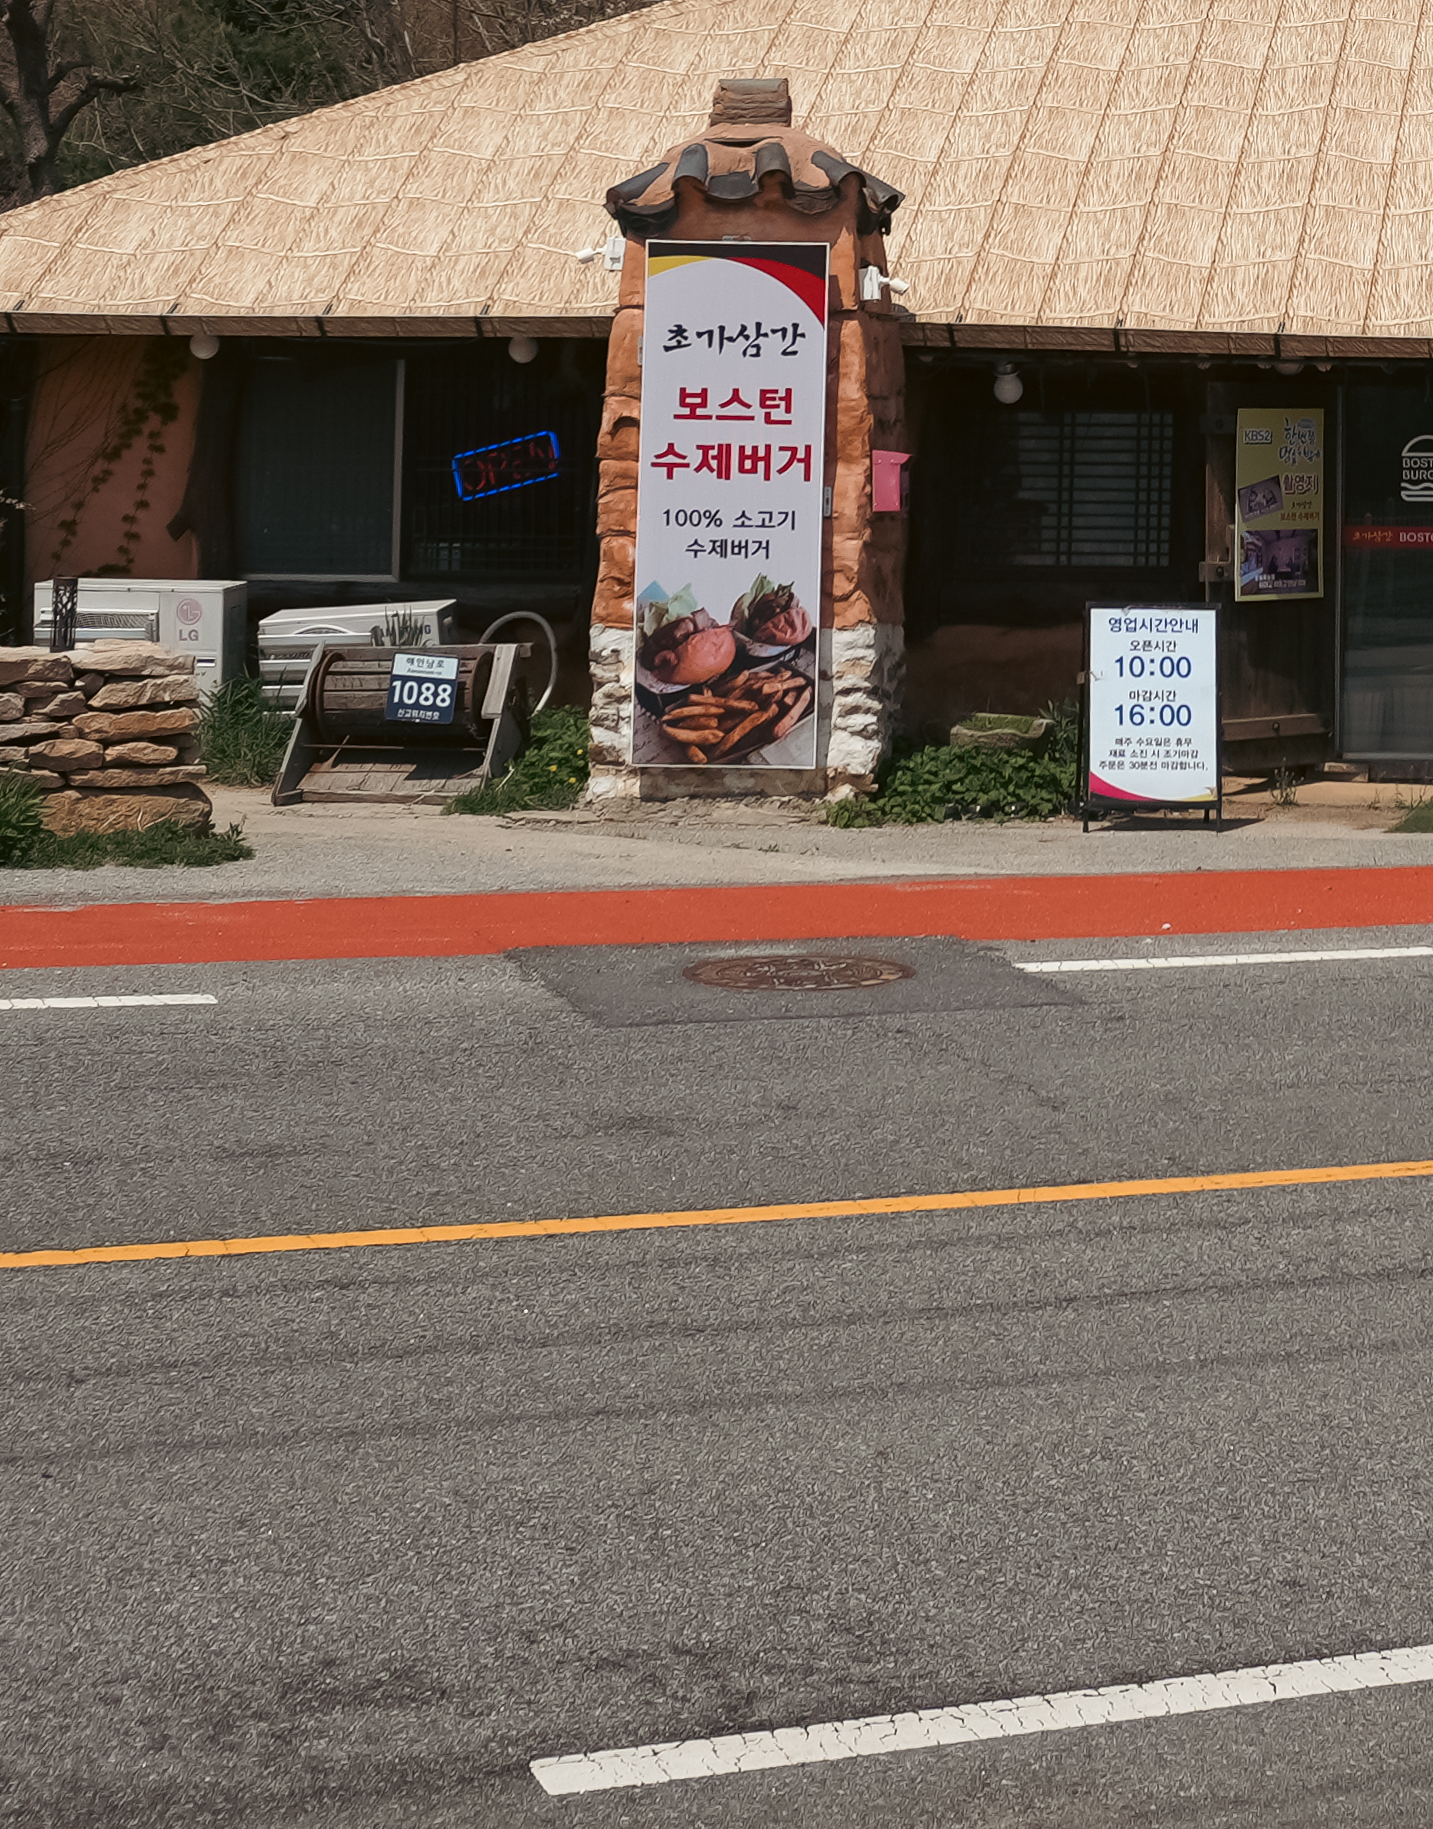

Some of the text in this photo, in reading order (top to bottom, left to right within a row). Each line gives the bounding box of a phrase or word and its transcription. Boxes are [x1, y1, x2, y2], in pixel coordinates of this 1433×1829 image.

[662, 322, 806, 358] 초가삼간
[673, 387, 793, 425] 보스턴
[1244, 430, 1272, 442] KBS2
[463, 442, 555, 490] OPEN
[650, 442, 812, 482] 수제버거
[663, 509, 796, 530] 100% 소고기
[685, 538, 770, 559] 수제버거
[179, 629, 199, 641] LG
[1108, 617, 1199, 634] 영업시간안내
[1129, 640, 1177, 653] 오픈시간
[1114, 655, 1192, 678] 10:00
[392, 680, 452, 707] 1088
[1129, 690, 1177, 702] 마감시간
[1114, 703, 1192, 726] 16:00
[1115, 737, 1192, 747] 매주 수요일은 휴무
[1130, 749, 1148, 758] 소진
[1151, 749, 1160, 758] 시
[1163, 749, 1199, 759] 조기마감
[1099, 761, 1125, 770] 주문은
